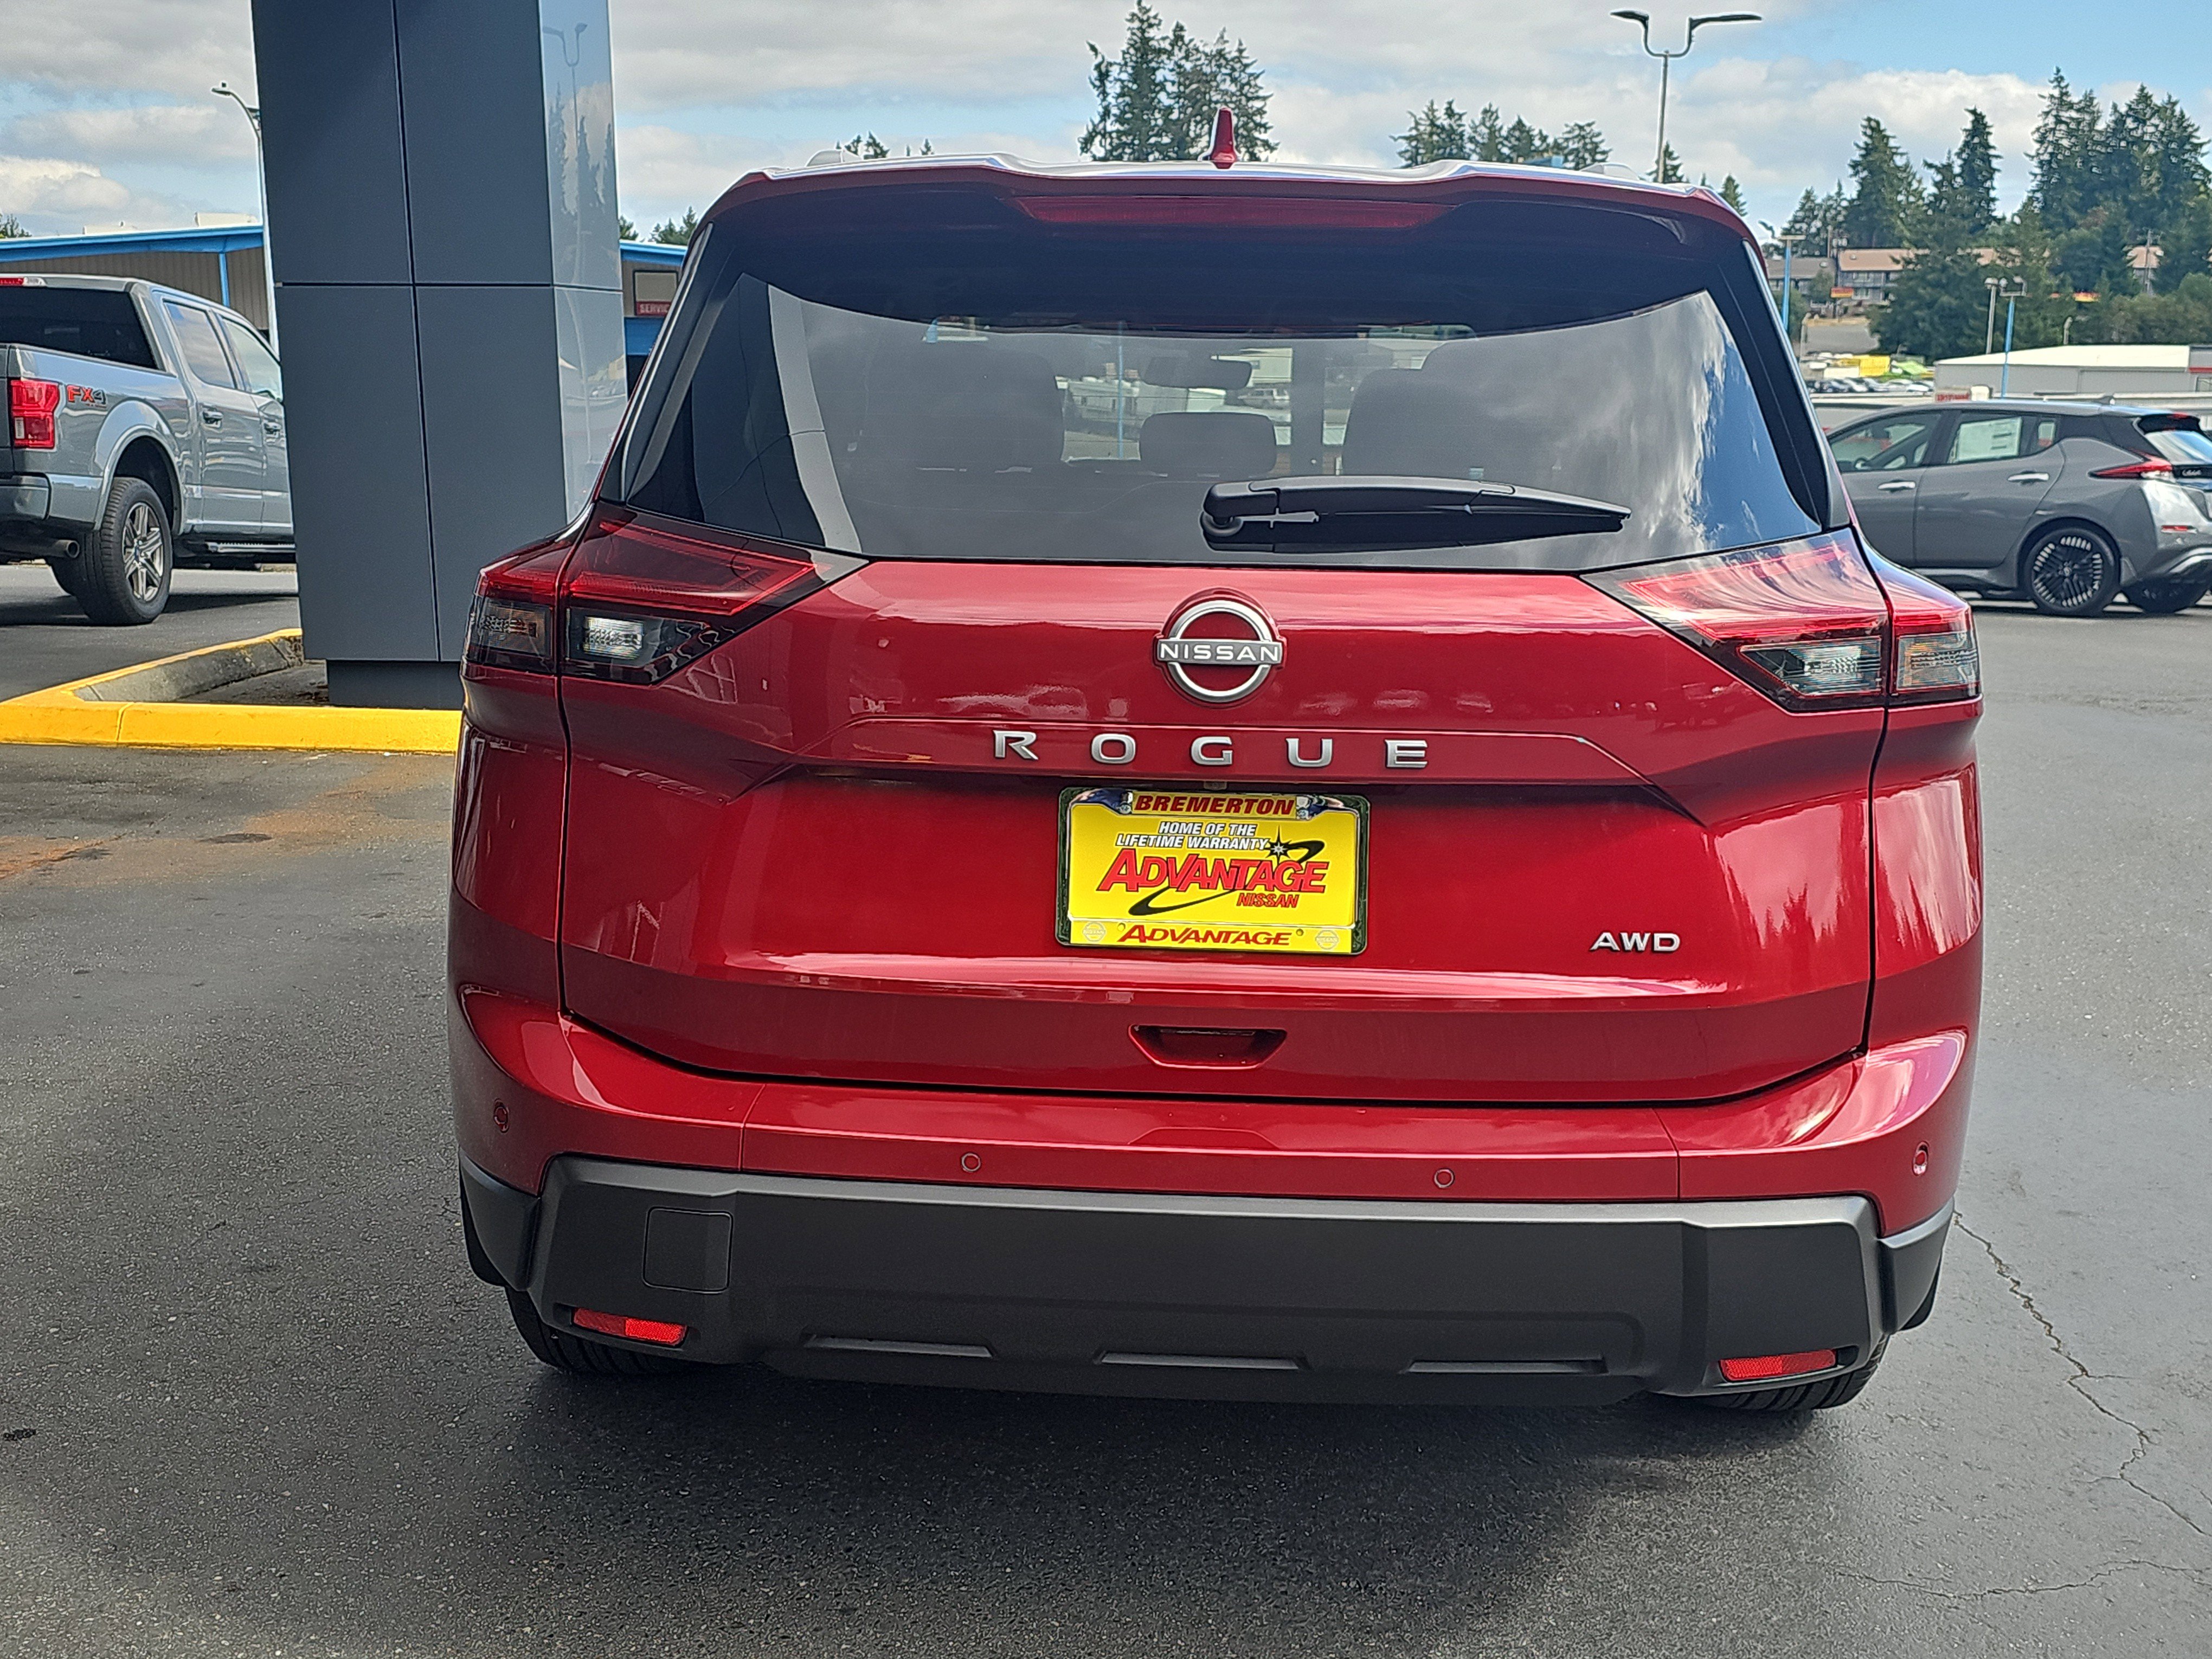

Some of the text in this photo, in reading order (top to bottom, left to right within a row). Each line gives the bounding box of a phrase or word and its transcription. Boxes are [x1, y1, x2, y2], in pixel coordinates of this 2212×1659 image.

[66, 384, 106, 405] FX4
[1159, 642, 1279, 662] NISSAN
[993, 730, 1428, 769] ROGUE
[1134, 795, 1295, 815] BREMERTON
[1159, 821, 1257, 837] HOME OF THE
[1116, 834, 1271, 850] LIFETIME WARRANTY
[1096, 848, 1330, 893] ADVANTAGE
[1236, 892, 1300, 908] NISSAN
[1117, 925, 1292, 946] ADVANTAGE
[1589, 932, 1680, 951] AWD
